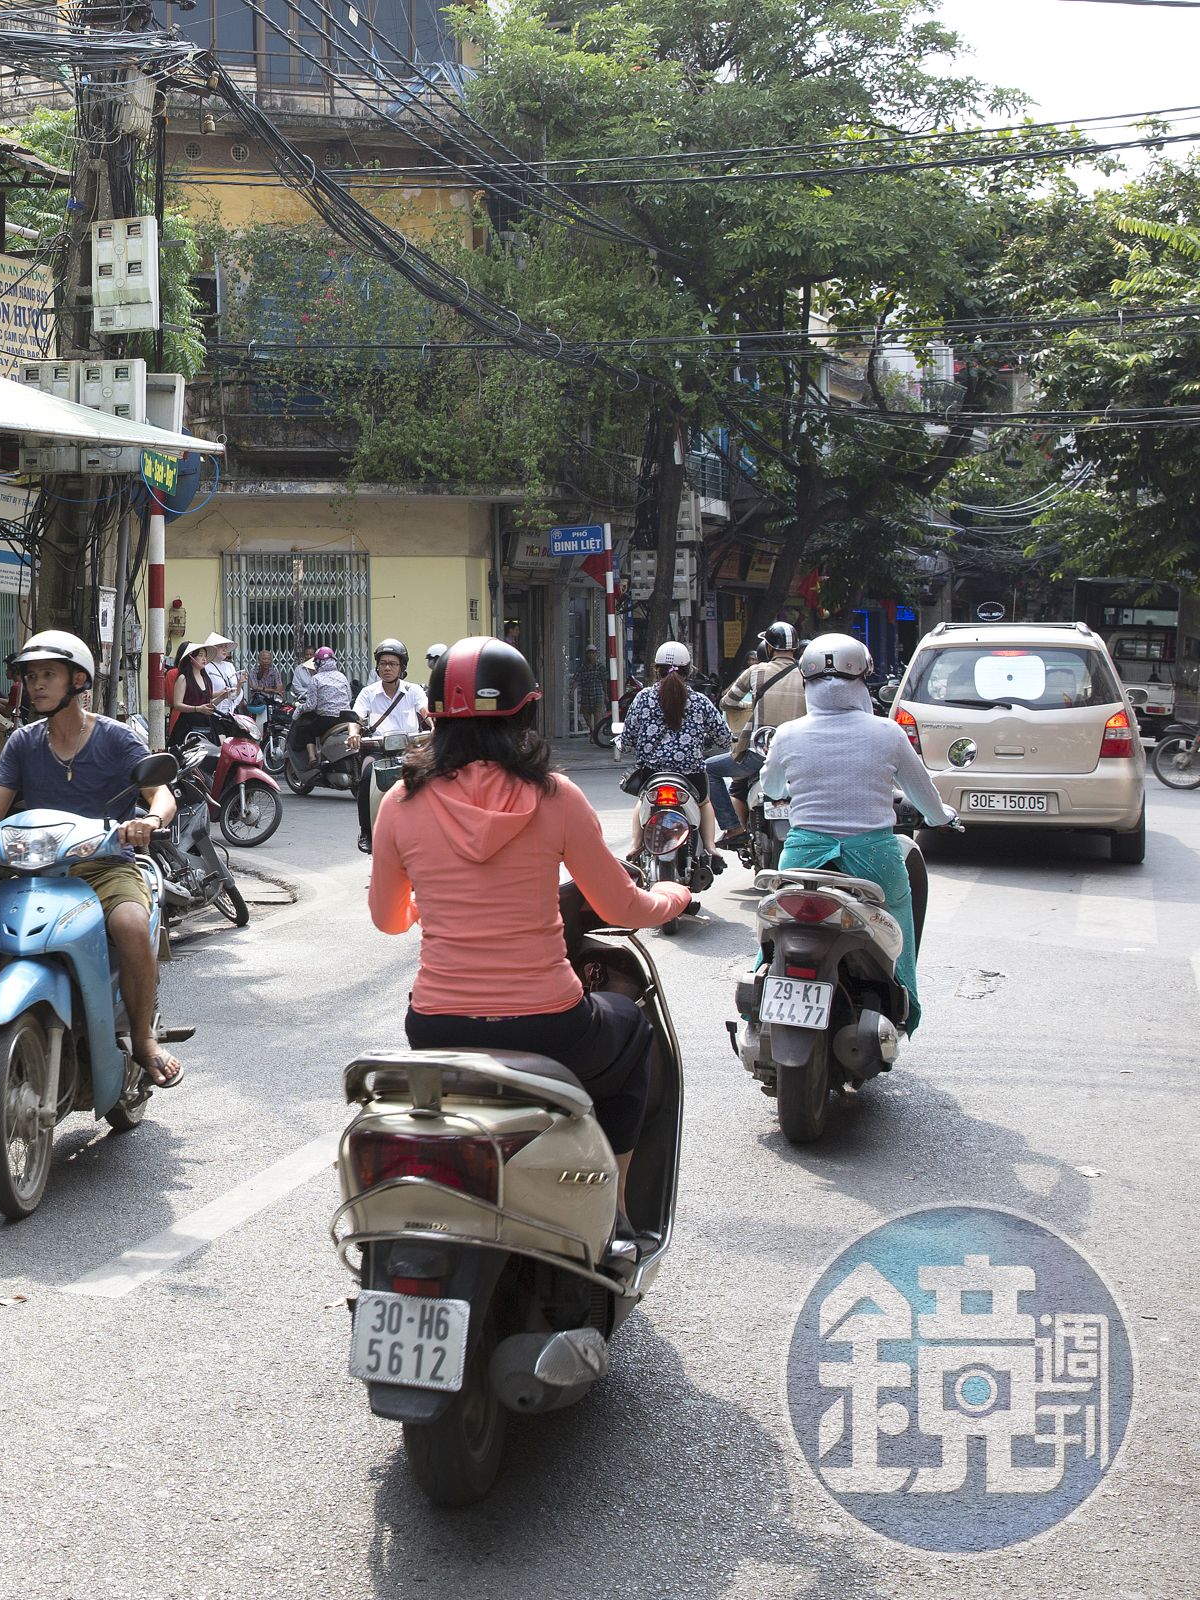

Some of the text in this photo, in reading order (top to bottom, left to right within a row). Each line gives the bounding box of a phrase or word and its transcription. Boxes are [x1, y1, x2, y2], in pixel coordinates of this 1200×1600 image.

[8, 264, 19, 277] AN
[571, 529, 588, 538] PHỐ
[554, 540, 579, 552] ĐINH
[581, 537, 601, 552] LIỆT
[971, 794, 1045, 811] 30E-150.05
[773, 981, 822, 1004] 29-K1
[764, 1000, 825, 1025] 444.77
[370, 1300, 450, 1341] 30-H6
[366, 1338, 447, 1382] 5612
